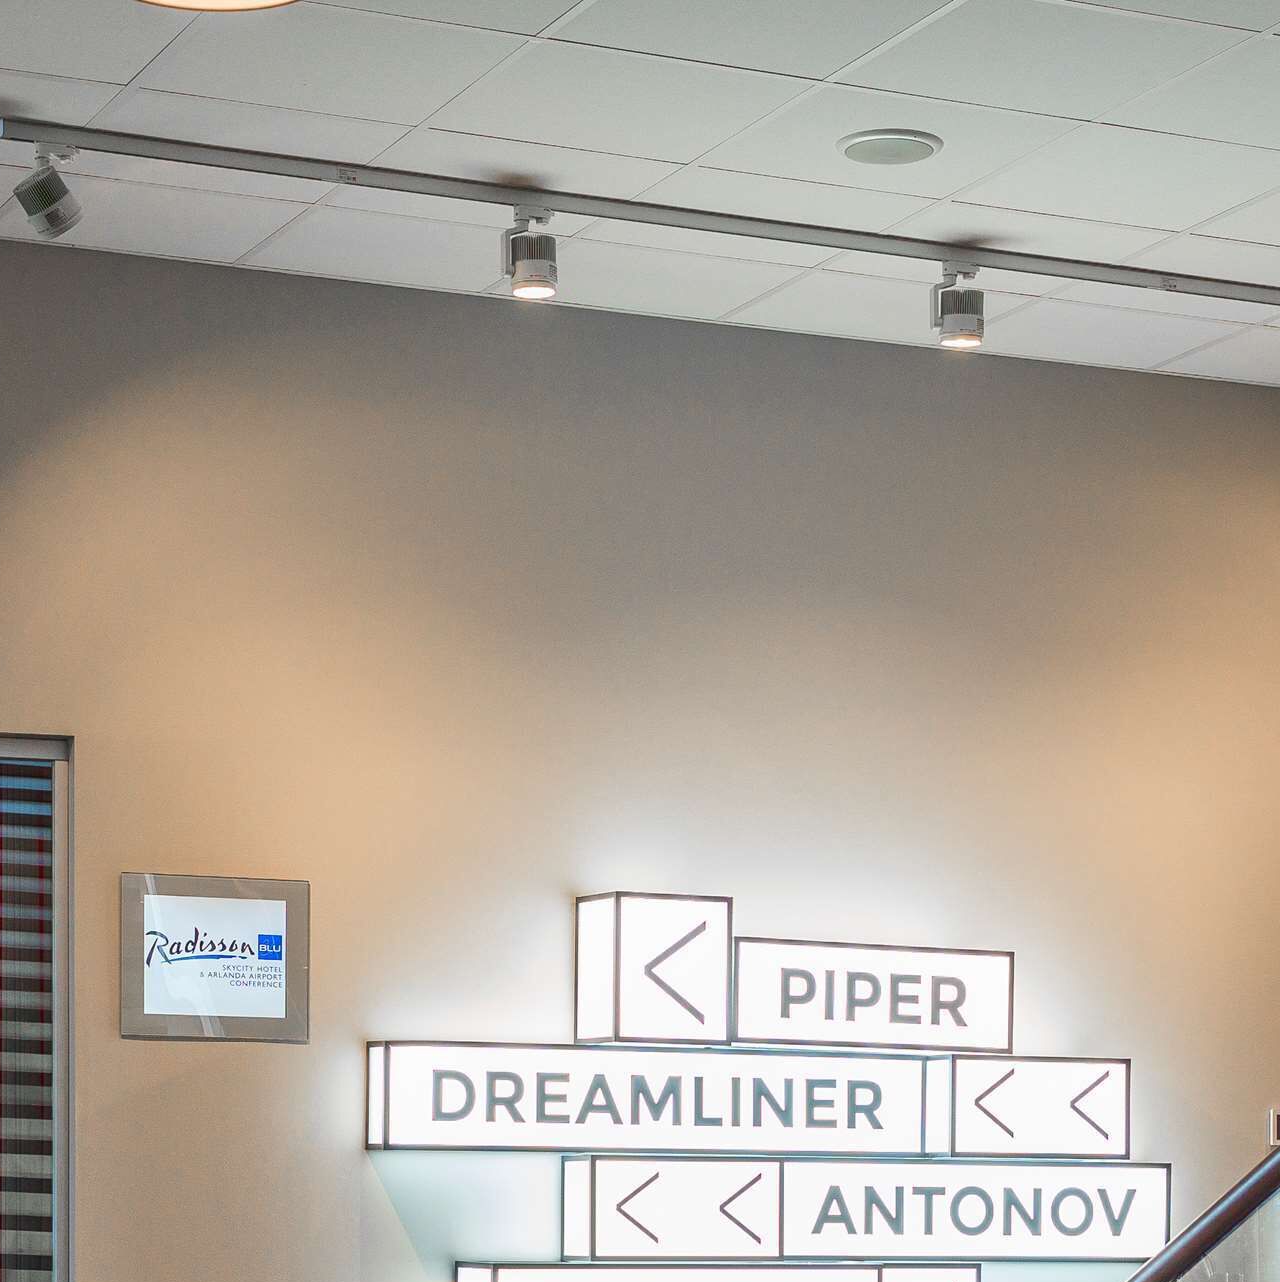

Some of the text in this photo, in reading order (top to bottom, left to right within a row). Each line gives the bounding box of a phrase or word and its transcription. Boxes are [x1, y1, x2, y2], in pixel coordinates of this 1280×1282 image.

[145, 926, 281, 968] Radisson BLU
[222, 964, 254, 972] SKYCITY
[207, 971, 247, 980] ARLANDA
[248, 973, 283, 981] AIRPORT
[229, 980, 283, 989] CONFERENCE
[780, 966, 968, 1028] PIPER
[432, 1069, 885, 1130] DREAMLINER
[811, 1185, 1137, 1238] ANTONOV
